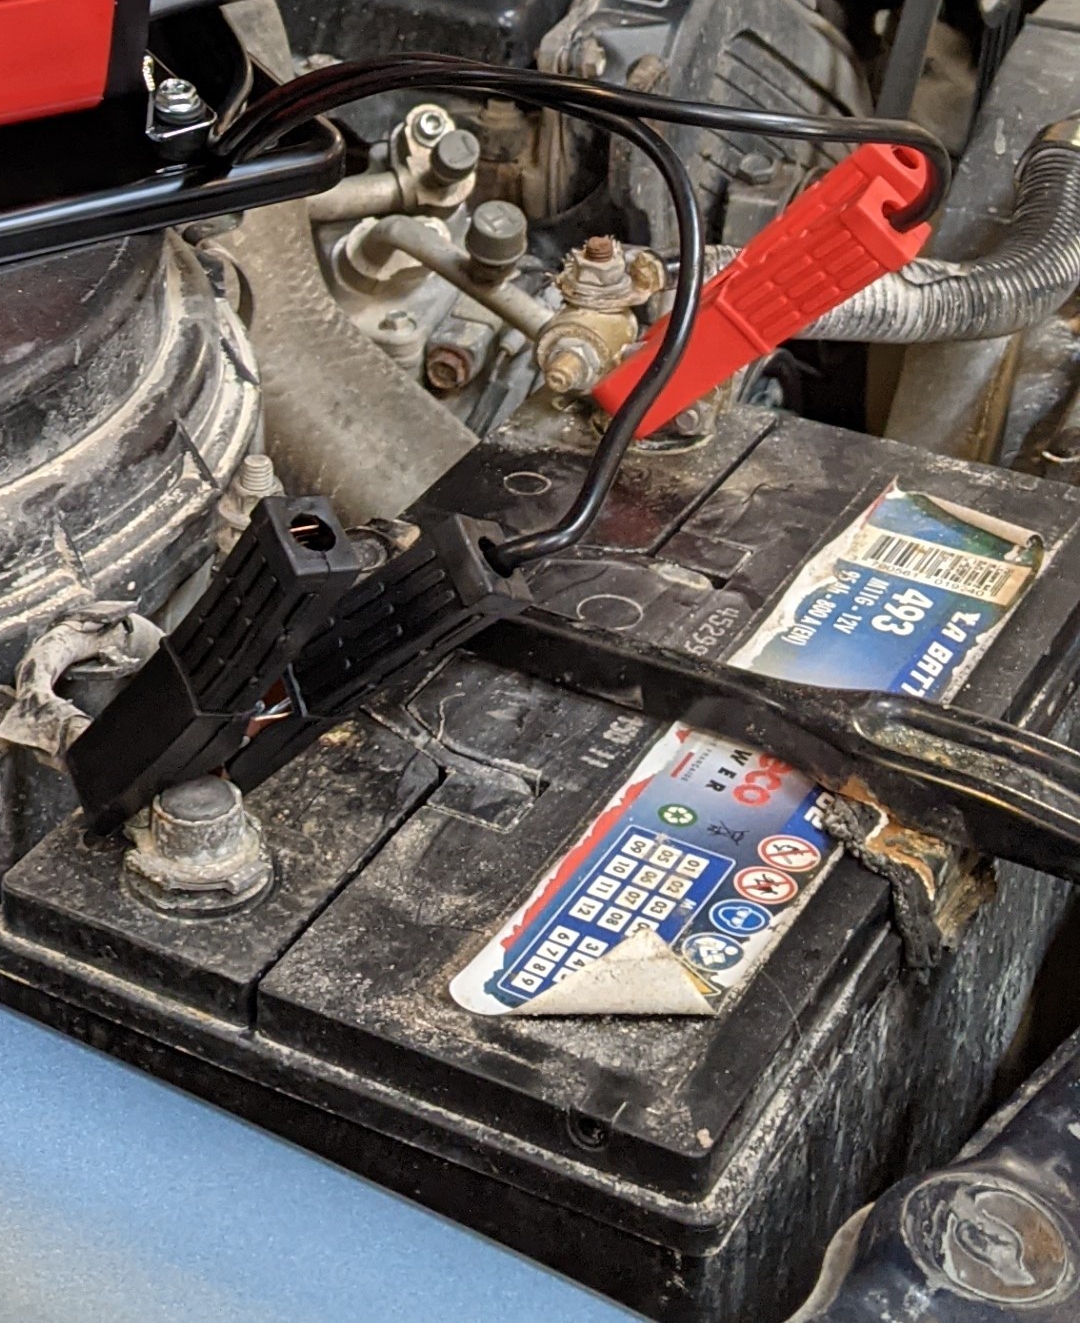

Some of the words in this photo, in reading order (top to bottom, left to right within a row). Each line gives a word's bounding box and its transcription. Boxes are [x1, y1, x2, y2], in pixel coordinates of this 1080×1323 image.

[807, 598, 837, 618] 800
[871, 588, 934, 636] 493
[800, 615, 822, 626] A
[832, 612, 862, 634] 12V
[683, 607, 740, 656] 45299
[780, 623, 817, 646] (EN)
[630, 840, 646, 854] 09
[657, 849, 674, 863] 05
[612, 861, 630, 874] 10
[683, 859, 700, 873] 01
[639, 870, 657, 884] 06
[595, 881, 613, 894] 11
[666, 880, 684, 893] 02
[624, 891, 641, 905] 07
[577, 902, 596, 916] 12
[650, 900, 668, 914] 03
[605, 912, 623, 926] 08
[557, 932, 570, 941] 6
[546, 947, 559, 957] 7
[585, 942, 599, 952] 3
[533, 962, 546, 971] 8
[572, 958, 586, 968] 4
[521, 977, 535, 986] 9
